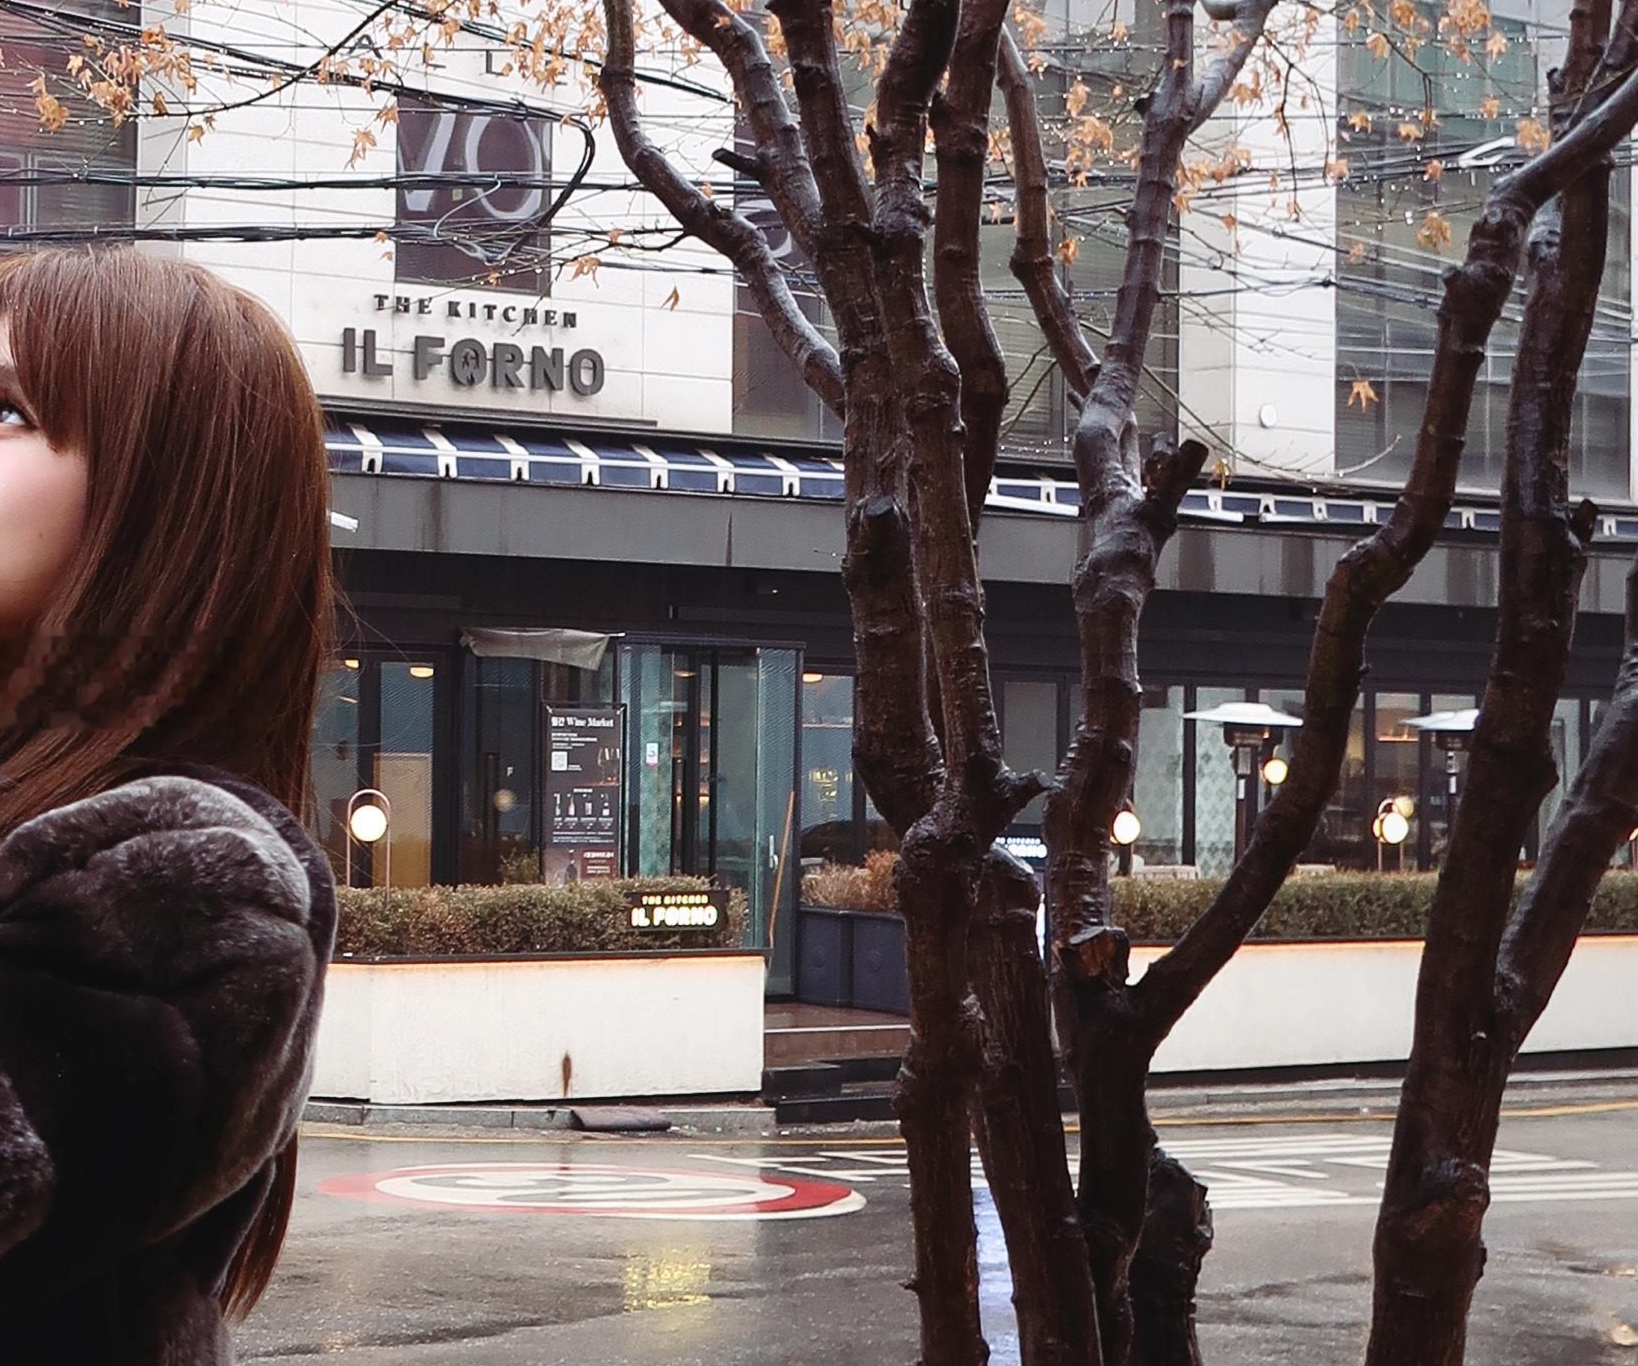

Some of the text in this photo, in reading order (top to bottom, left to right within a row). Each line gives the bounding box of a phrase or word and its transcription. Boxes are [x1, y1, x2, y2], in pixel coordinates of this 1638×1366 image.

[373, 294, 578, 329] THE KITCHEN
[342, 327, 605, 397] IL FORNO
[631, 905, 718, 927] IL FORNO
